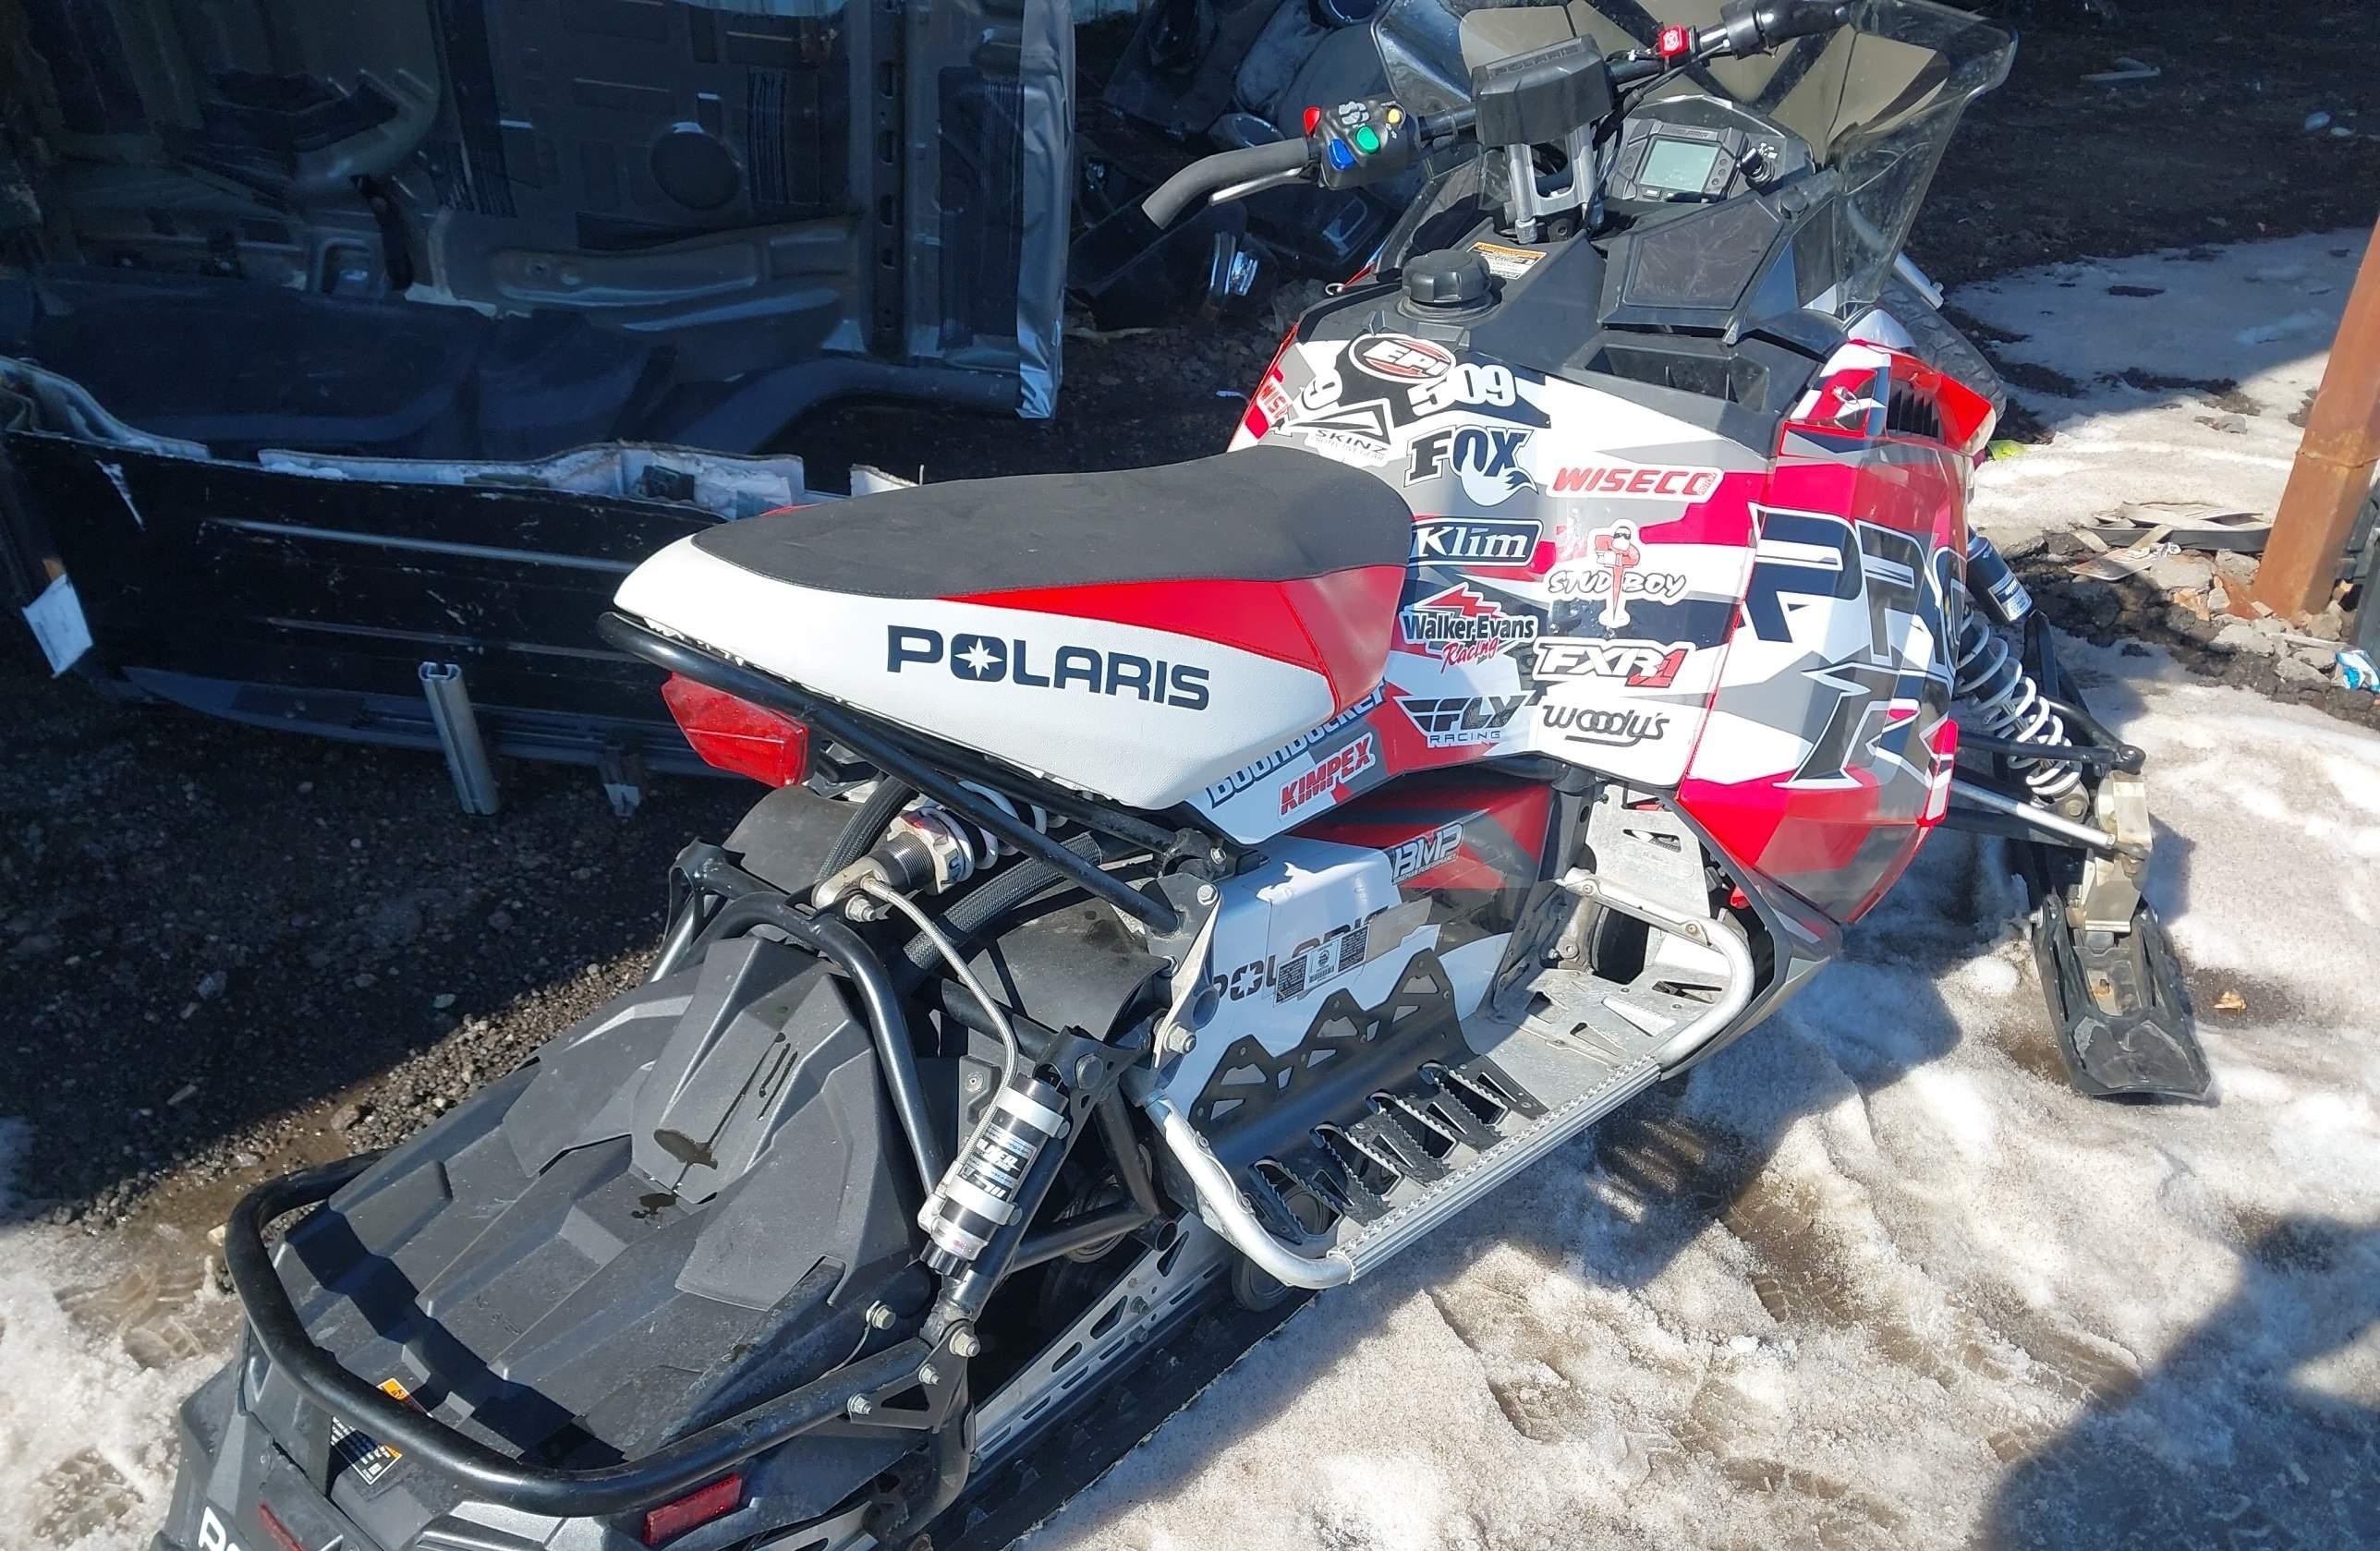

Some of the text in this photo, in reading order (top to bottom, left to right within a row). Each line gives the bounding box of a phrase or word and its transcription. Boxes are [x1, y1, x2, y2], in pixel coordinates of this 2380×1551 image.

[1406, 364, 1516, 418] 509
[1315, 430, 1390, 454] SKINZ
[1405, 425, 1532, 490] FOX
[1552, 467, 1718, 496] WISECO
[1548, 570, 1686, 597] STUD BOY
[1402, 613, 1535, 640] Walker Evans
[886, 624, 1210, 710] POLARIS
[1440, 637, 1499, 674] Racing
[1401, 695, 1530, 732] FLY
[1429, 730, 1500, 745] RACING
[1281, 736, 1372, 816] KIMPEX
[1392, 823, 1463, 881] BMP
[198, 1506, 242, 1551] P
